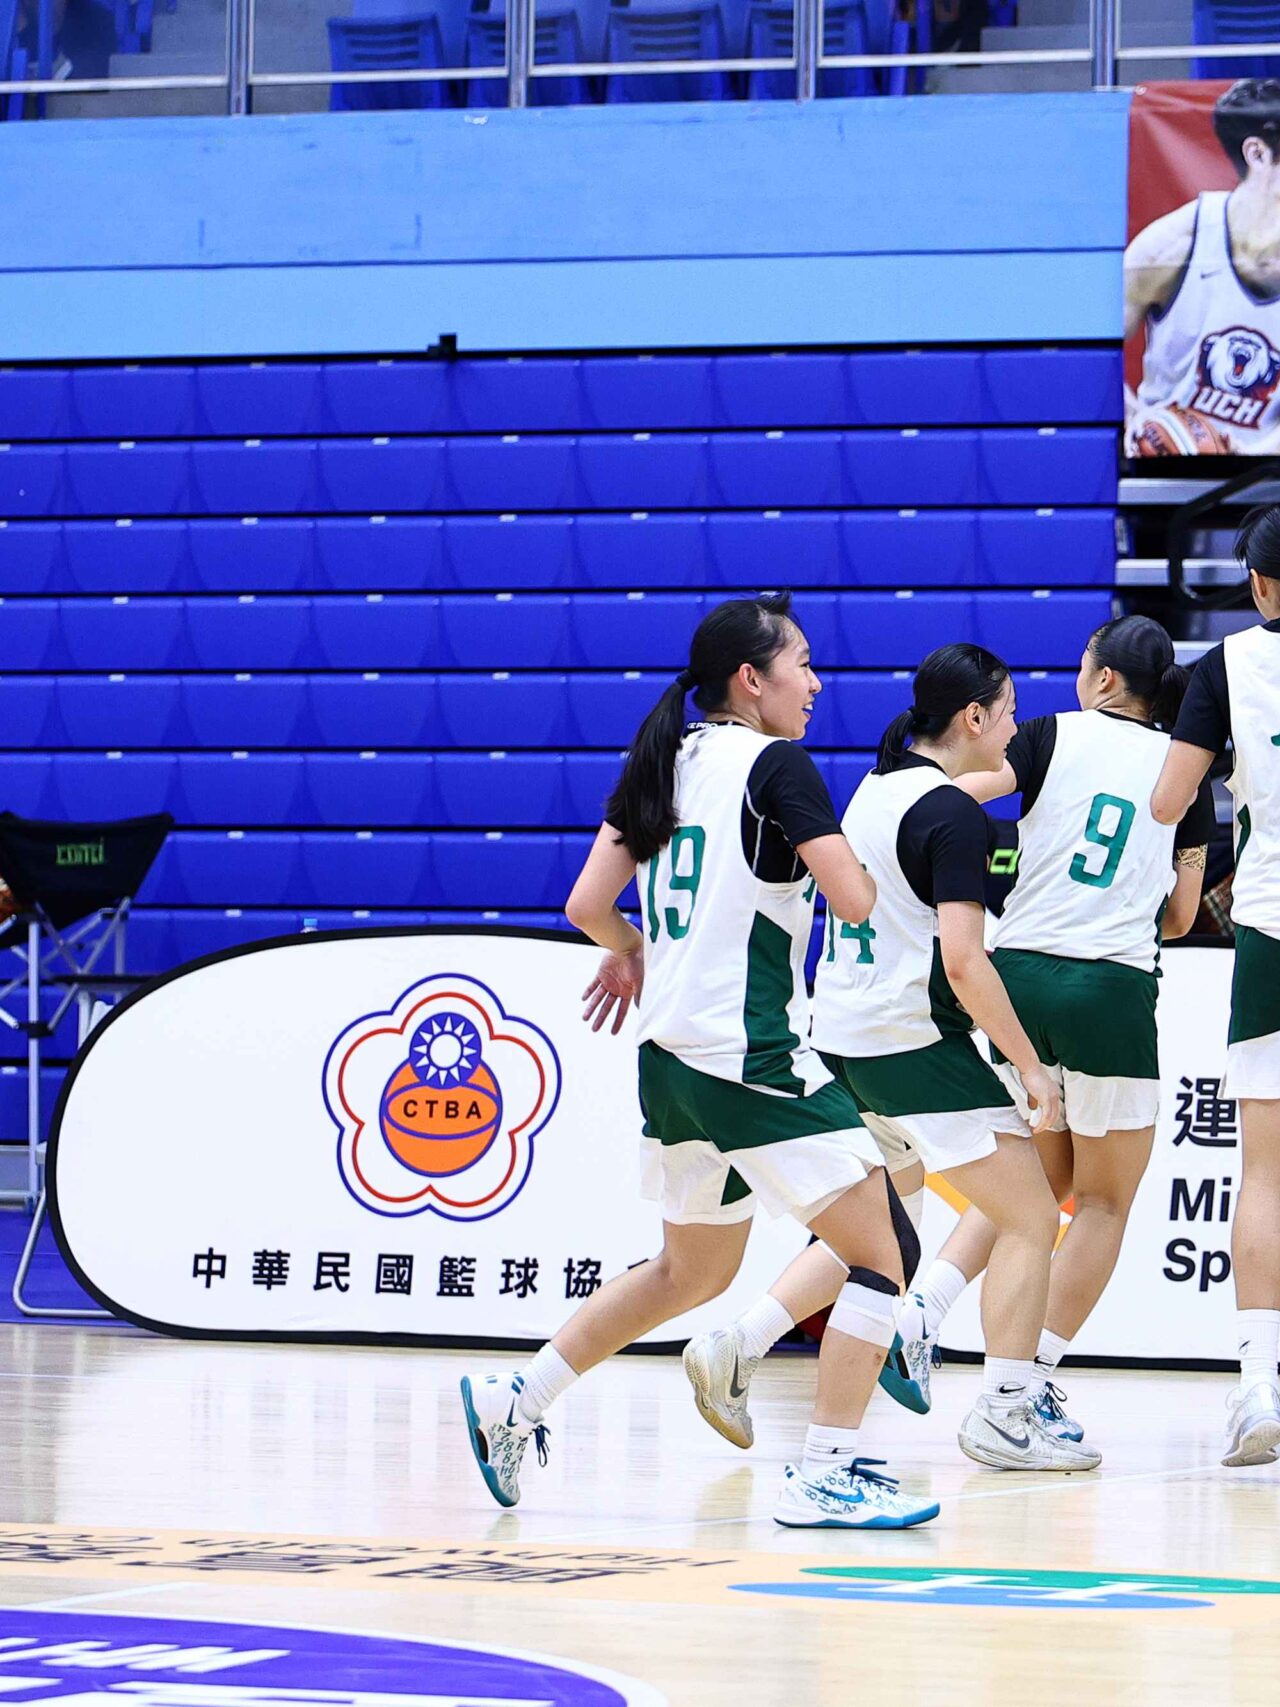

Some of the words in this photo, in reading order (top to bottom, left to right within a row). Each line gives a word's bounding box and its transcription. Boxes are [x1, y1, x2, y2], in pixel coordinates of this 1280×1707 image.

[1192, 385, 1264, 425] UCH
[1068, 791, 1137, 888] 9
[648, 825, 706, 944] 19
[827, 864, 877, 964] 14
[402, 1099, 482, 1120] CTBA
[192, 1246, 648, 1299] 中華民國籃球協
